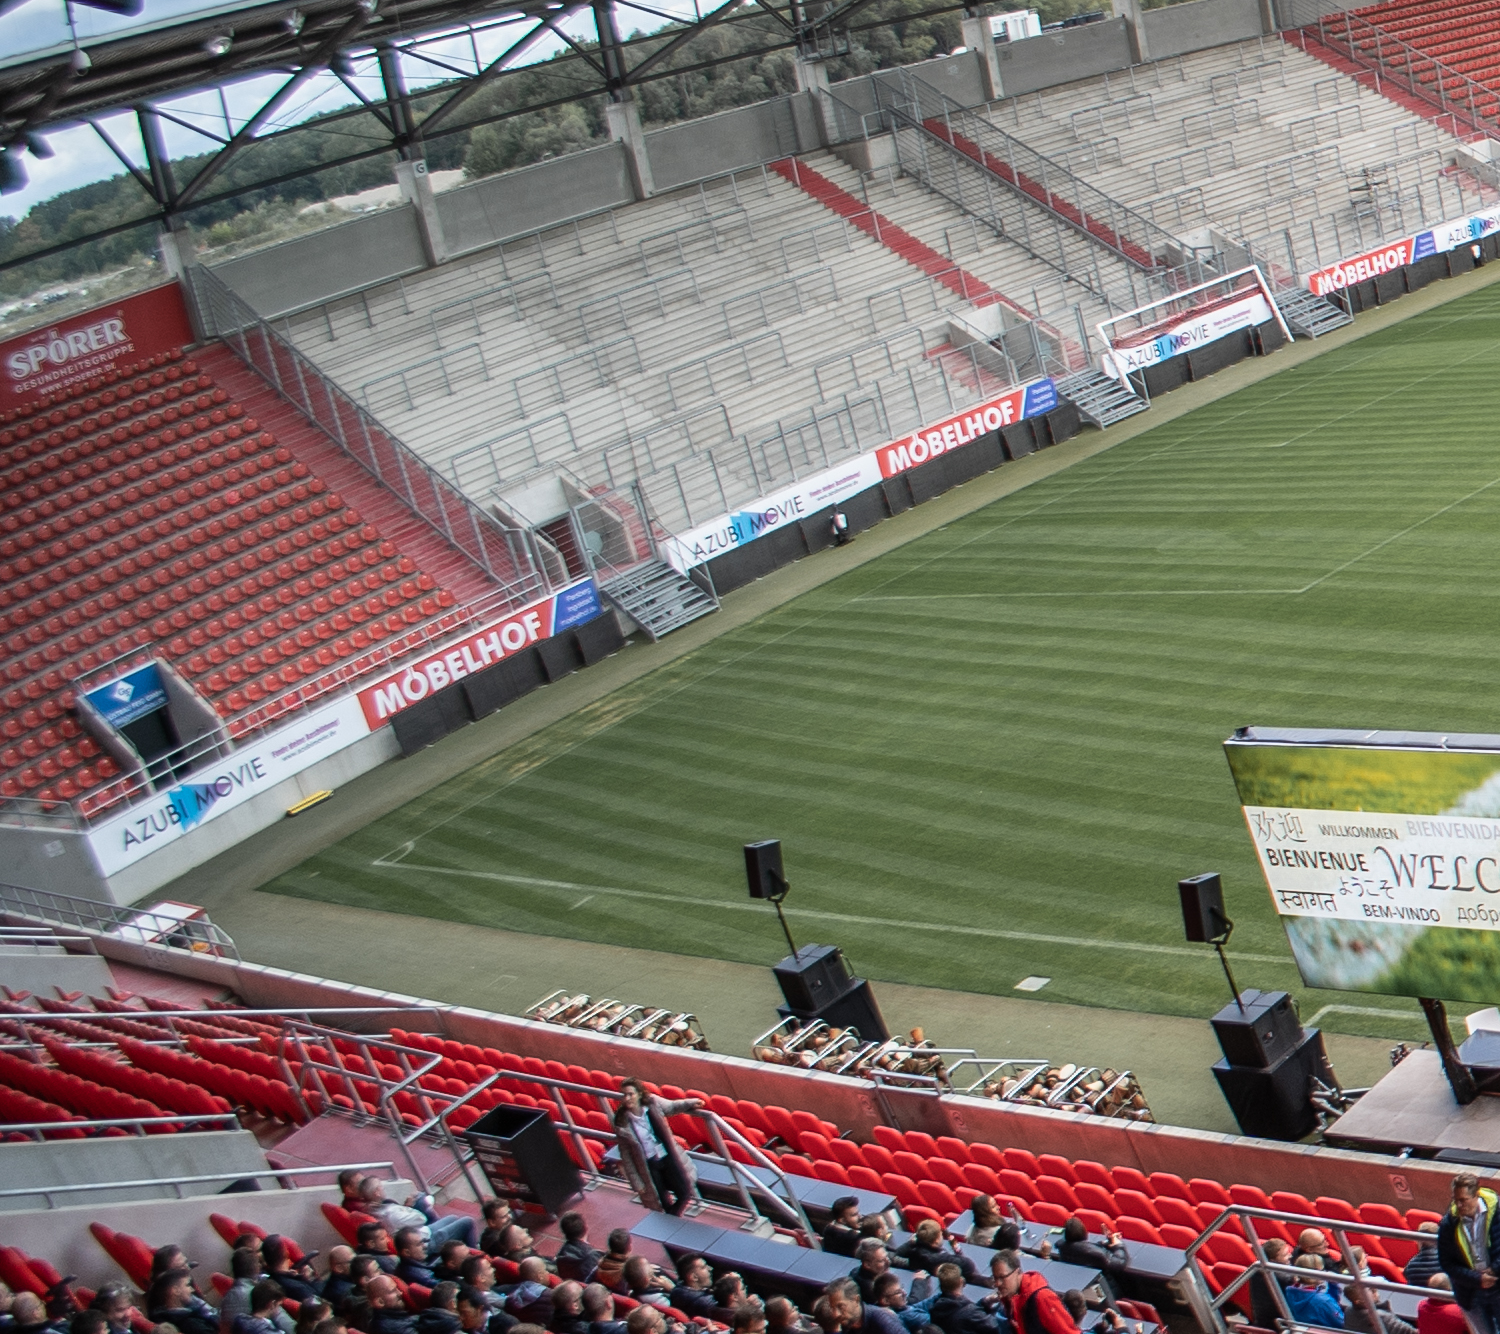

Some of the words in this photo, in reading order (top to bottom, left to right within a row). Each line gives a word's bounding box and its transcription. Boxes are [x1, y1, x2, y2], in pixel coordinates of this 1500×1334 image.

[1318, 245, 1407, 295] MÖBELHOF
[15, 343, 135, 394] GESUNDHEITSGRUPPE
[1128, 341, 1165, 369] AZUBI
[1170, 323, 1210, 353] MOVIE
[887, 399, 1014, 475] MÖBELHOF
[693, 521, 745, 560] AZUBI
[750, 495, 804, 535] MOVIE
[373, 611, 542, 720] MÖBELHOF
[124, 798, 189, 852] AZUBI
[195, 757, 267, 814] MOVIE
[1250, 811, 1308, 842] 欢迎
[1318, 823, 1400, 840] WILLKOMMEN
[1266, 848, 1370, 872] BIENVENUE
[1277, 889, 1339, 912] स्वागत
[1339, 876, 1395, 900] ようこそ
[1362, 903, 1441, 922] BEM-VINDO
